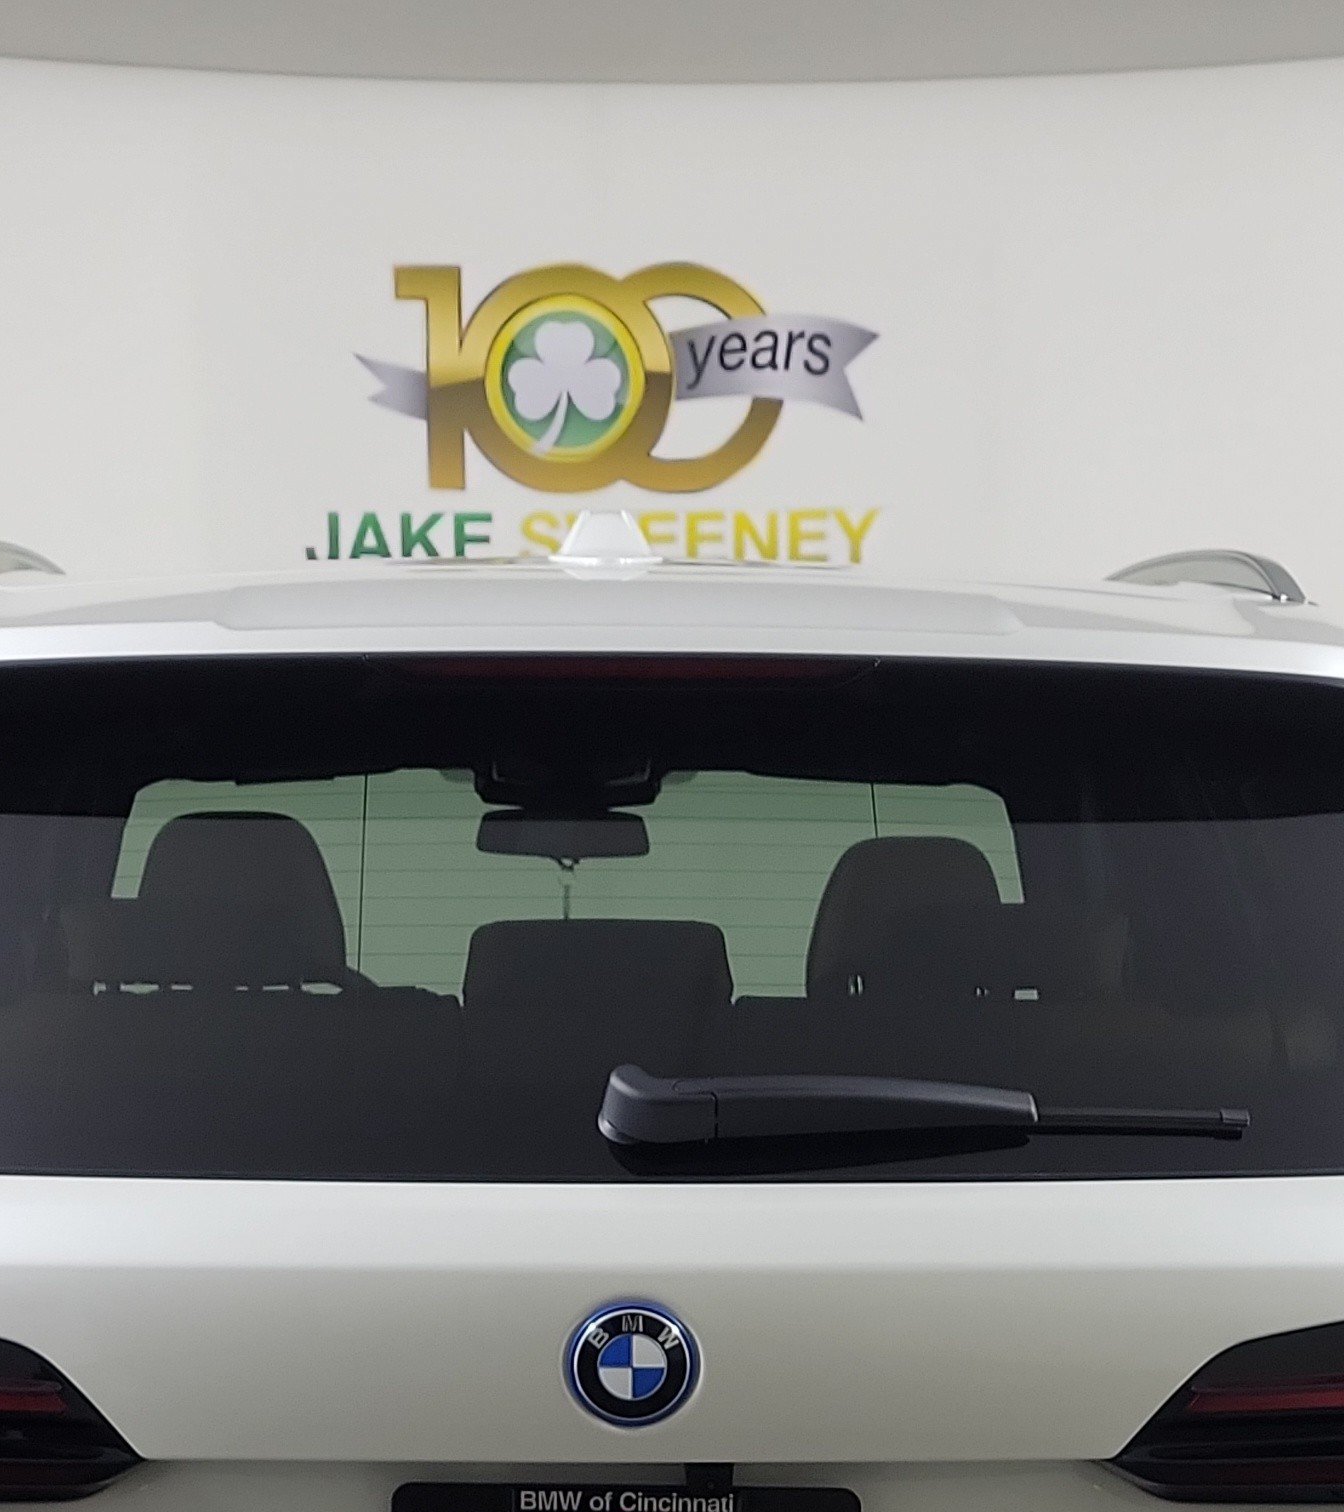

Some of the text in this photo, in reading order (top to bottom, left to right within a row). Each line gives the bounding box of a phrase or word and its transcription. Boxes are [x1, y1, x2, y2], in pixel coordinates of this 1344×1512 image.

[686, 328, 831, 388] years
[306, 509, 880, 564] JAKE SEENEY
[587, 1314, 679, 1349] BMW
[520, 1490, 734, 1512] BMW of Cincinnati
